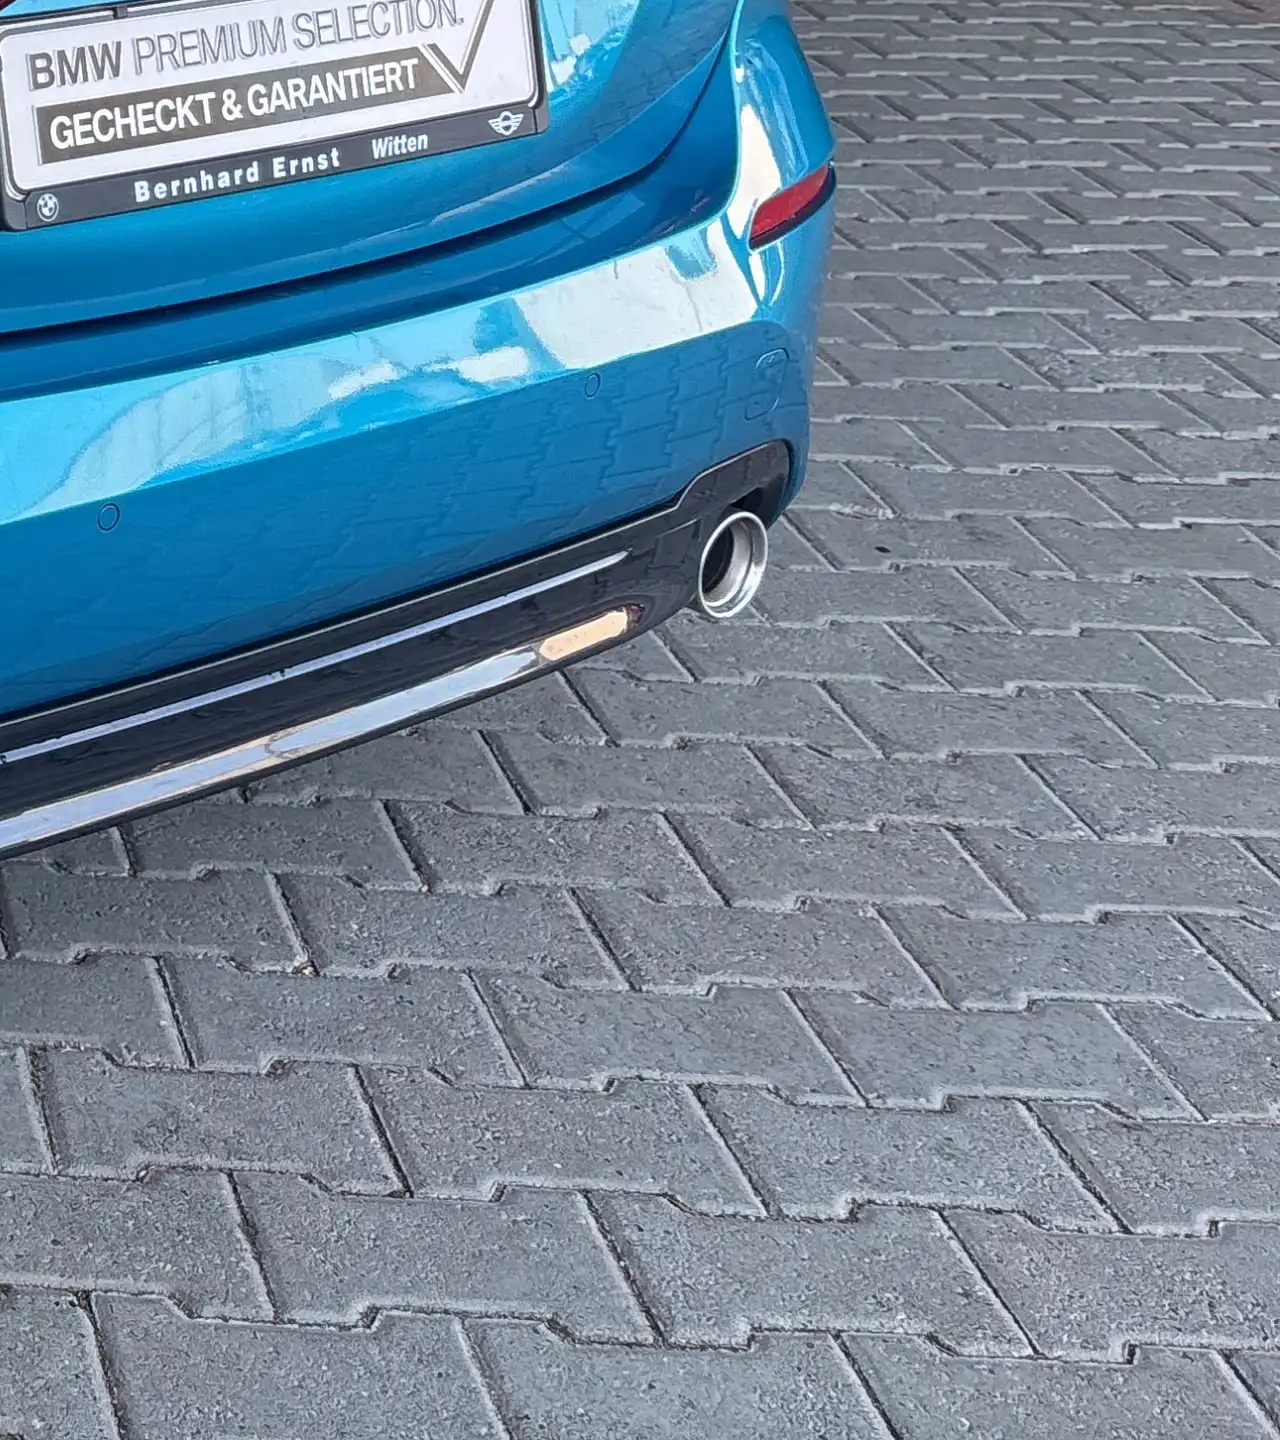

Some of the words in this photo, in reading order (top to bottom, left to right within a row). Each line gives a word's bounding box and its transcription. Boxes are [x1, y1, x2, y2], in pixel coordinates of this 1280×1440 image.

[28, 40, 122, 91] BMW
[132, 14, 288, 76] PREMIUM
[49, 91, 217, 150] GECHECKT
[221, 88, 243, 121] &
[246, 58, 420, 116] GARANTIERT
[134, 162, 261, 204] Bernhard
[272, 146, 342, 180] Ernst
[370, 130, 430, 160] Witten
